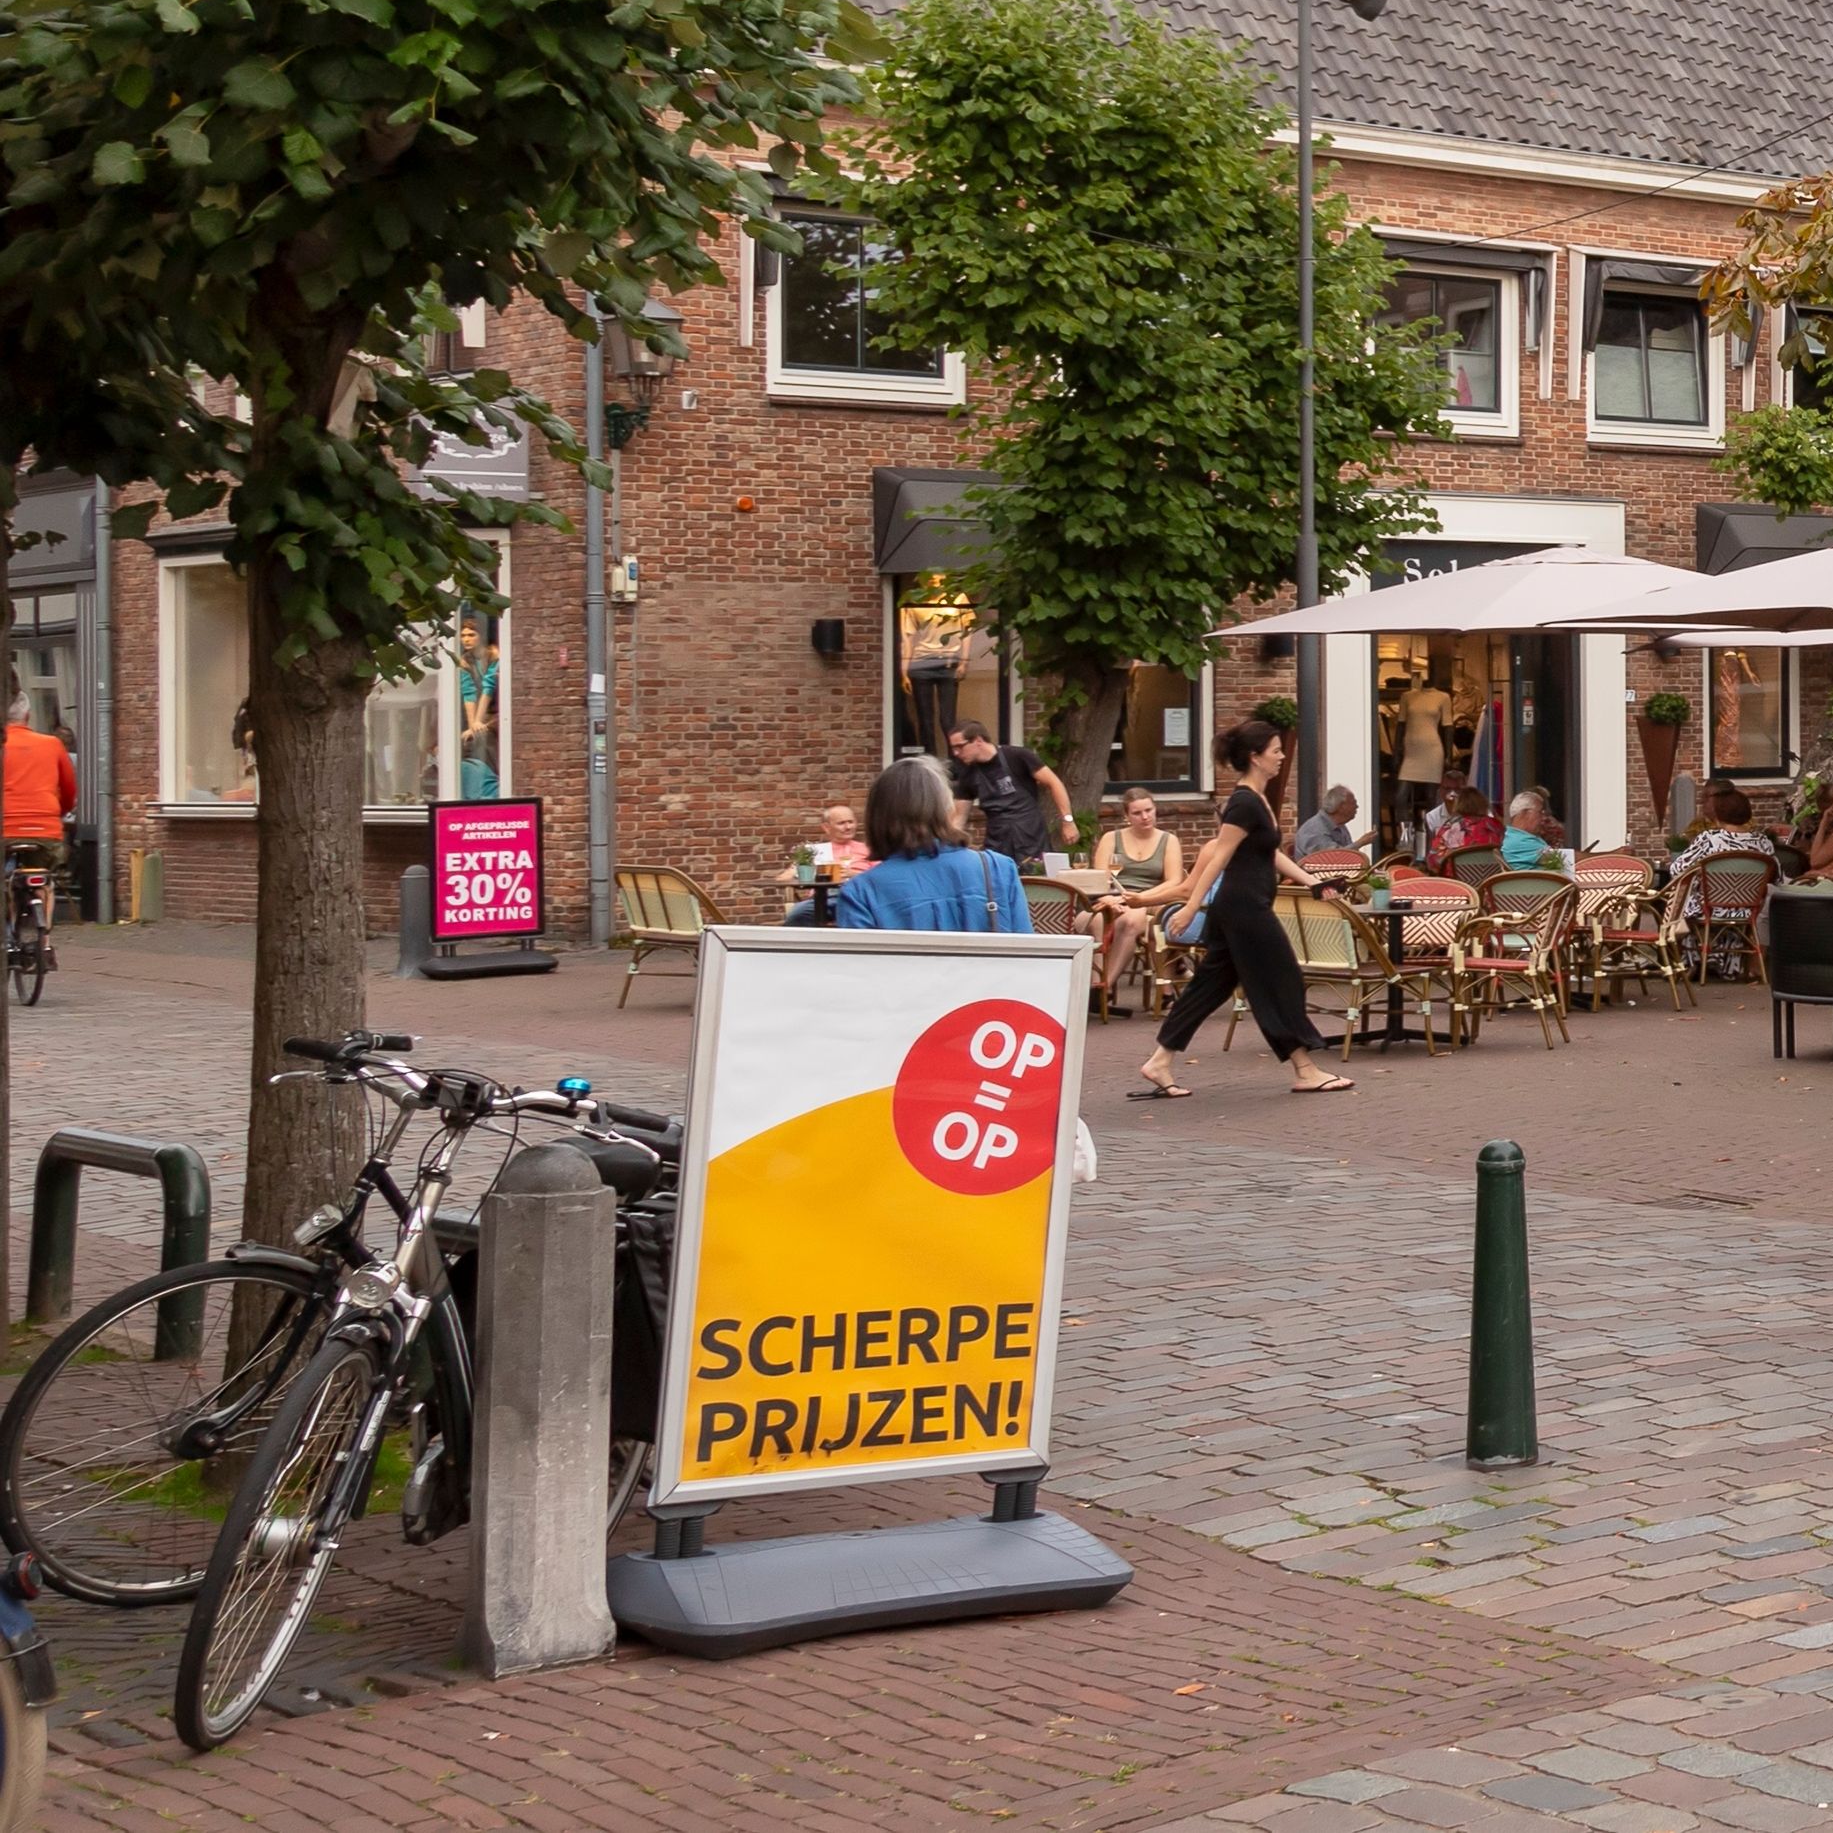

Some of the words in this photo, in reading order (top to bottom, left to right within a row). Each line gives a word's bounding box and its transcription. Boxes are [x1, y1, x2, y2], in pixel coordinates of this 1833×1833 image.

[449, 823, 463, 831] OP
[462, 831, 517, 840] ARTIKELEN
[445, 850, 534, 872] EXTRA
[445, 872, 532, 906] 30%
[444, 906, 533, 923] KORTING
[969, 1020, 1056, 1079] OP
[932, 1111, 1019, 1170] OP
[696, 1302, 1034, 1380] SCHERPE
[696, 1380, 1023, 1463] PRIJZEN!
